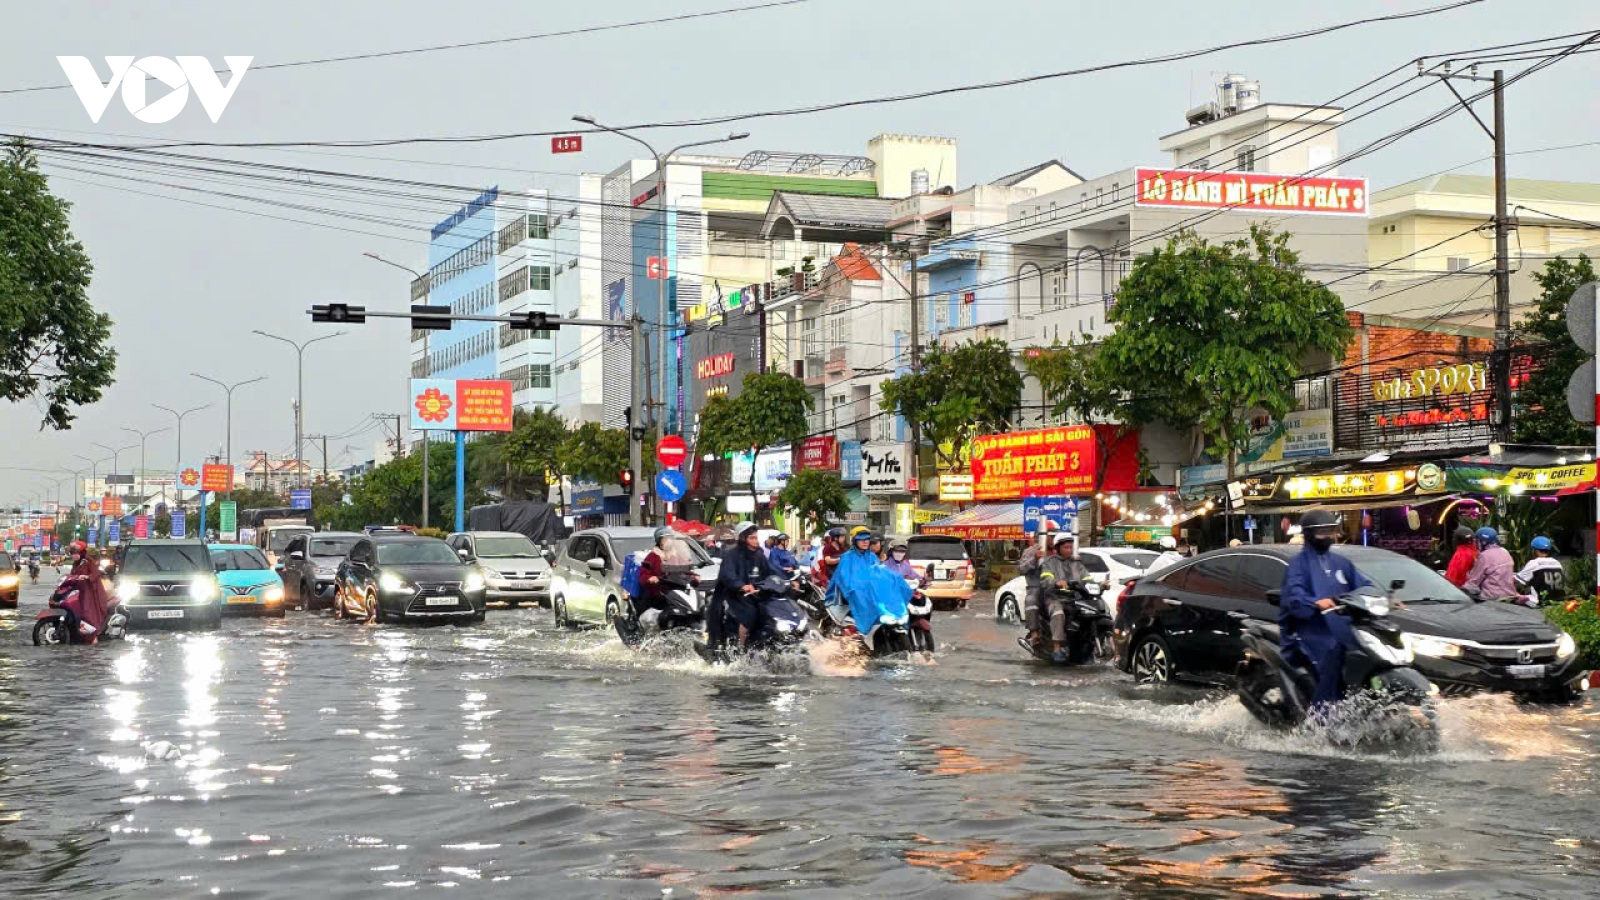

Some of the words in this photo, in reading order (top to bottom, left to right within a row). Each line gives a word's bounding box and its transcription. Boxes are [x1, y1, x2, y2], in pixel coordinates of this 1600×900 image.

[1143, 172, 1165, 200] LÒ
[1171, 176, 1222, 203] BÁNH
[1225, 179, 1249, 205] MÌ
[1251, 179, 1300, 207] TUẤN
[1303, 182, 1350, 209] PHÁT
[1353, 189, 1364, 209] 3
[698, 353, 734, 380] HOLIDAY
[1411, 362, 1488, 397] SPORT
[983, 452, 1024, 477] TUẤN
[1025, 448, 1067, 473] PHÁT
[1070, 451, 1080, 471] 3
[1551, 467, 1586, 479] COFFEE
[1317, 486, 1339, 495] WITH
[1341, 485, 1375, 494] COFFEE
